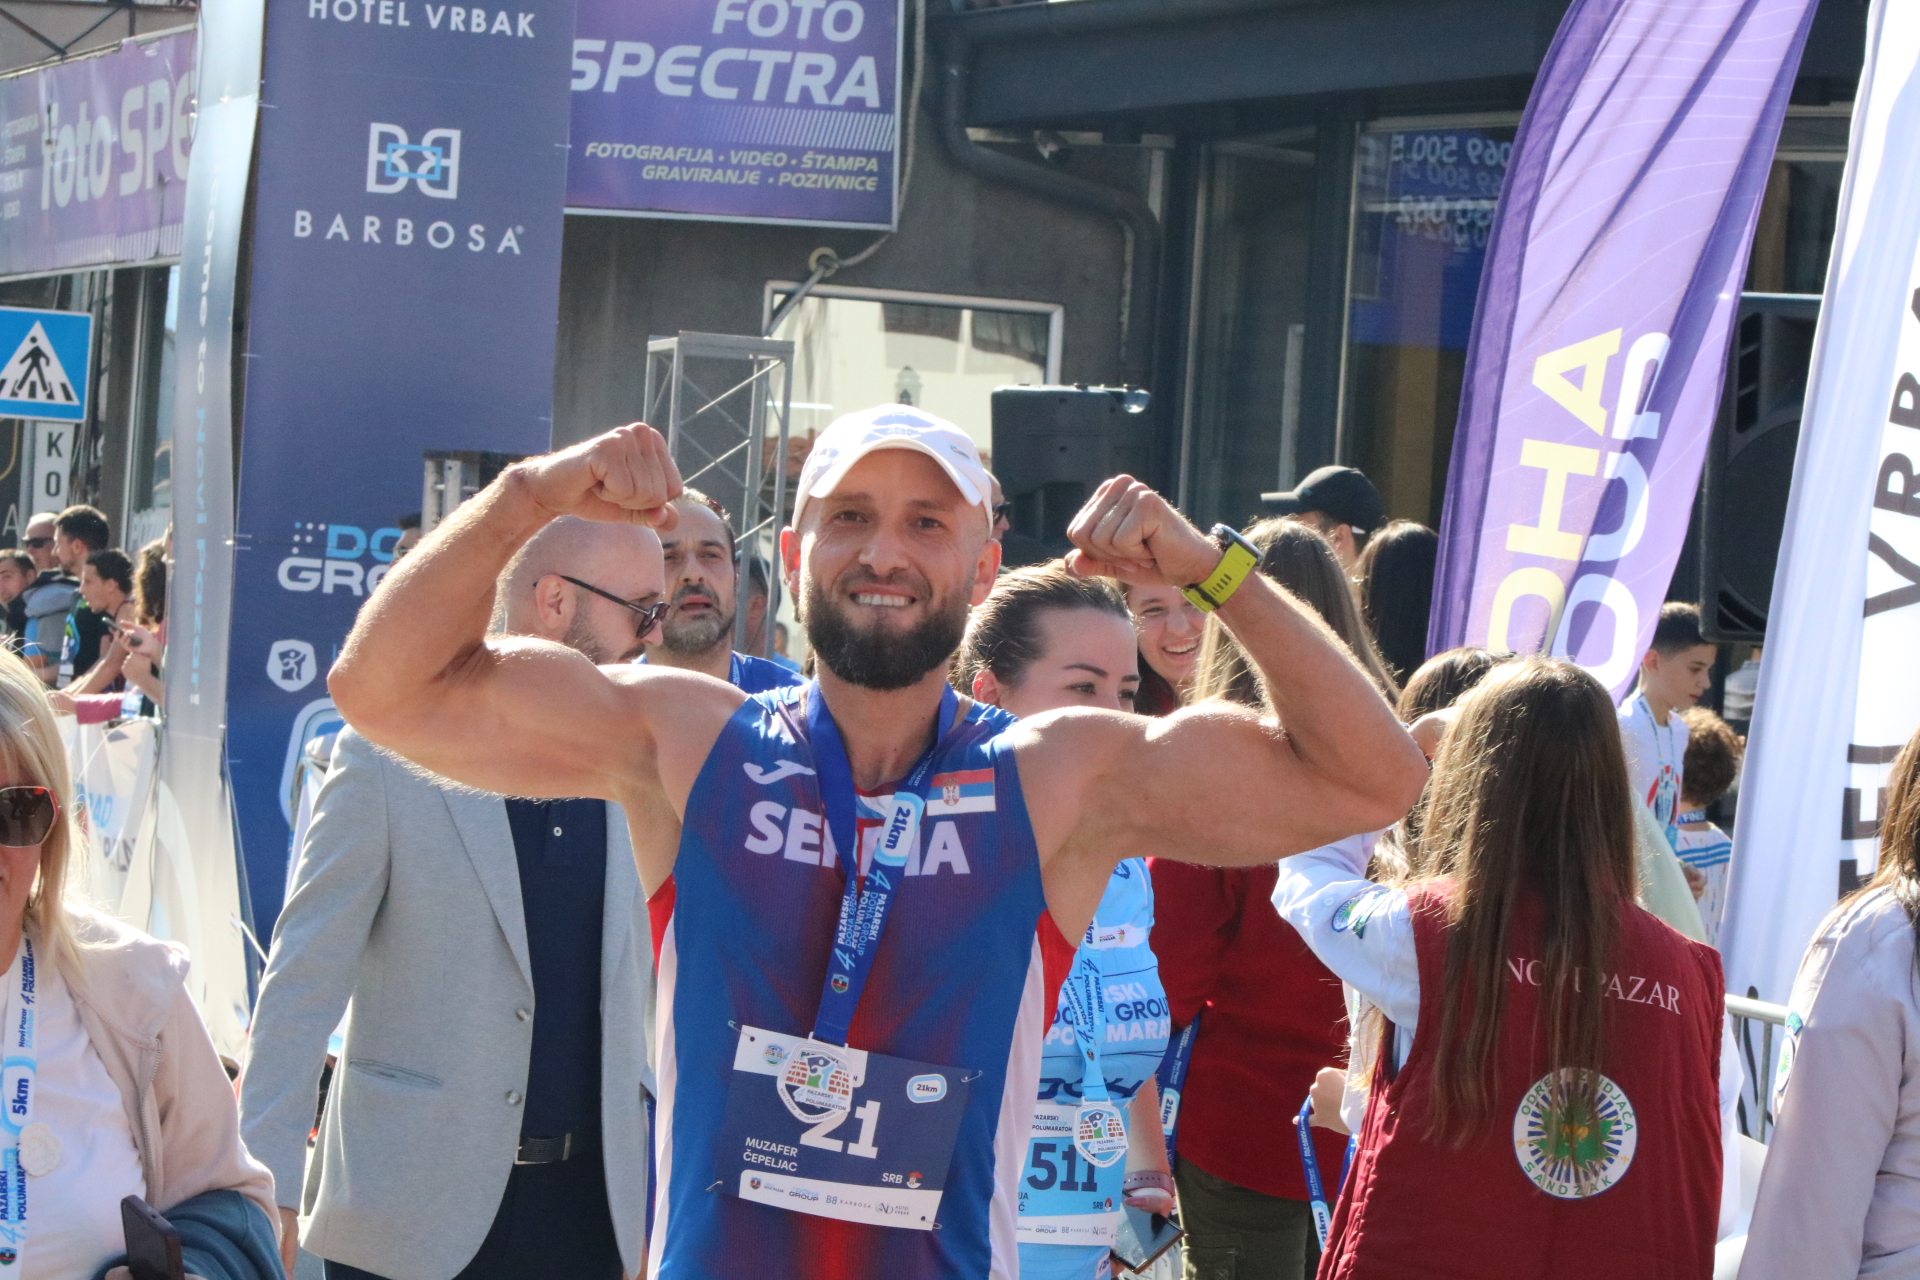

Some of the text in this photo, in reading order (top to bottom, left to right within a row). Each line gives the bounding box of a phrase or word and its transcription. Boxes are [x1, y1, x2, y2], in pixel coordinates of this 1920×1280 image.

[308, 0, 536, 38] HOTEL VRBAK
[711, 0, 866, 43] FOTO
[570, 38, 882, 109] SPECTRA
[585, 141, 879, 173] FOTOGRAFIJA VIDEO ŠTAMPA
[641, 164, 879, 192] GRAVIRANJE POZIVNICE
[294, 210, 521, 255] BARBOSA
[744, 800, 972, 878] SEIA
[885, 806, 912, 850] 21km
[837, 895, 851, 945] PAZARSKI
[857, 891, 879, 956] DOHA GROUP
[867, 893, 888, 941] PAZARSKI
[1094, 976, 1105, 1013] PAZARSKI
[12, 1077, 30, 1117] 5km
[915, 1083, 939, 1094] 21km
[800, 1099, 881, 1159] 21
[1161, 1097, 1174, 1125] 21km
[743, 1148, 798, 1173] ČEPELJAC
[745, 1136, 799, 1158] MUZAFER
[881, 1172, 903, 1184] SRB
[1026, 1142, 1098, 1193] 511
[789, 1191, 819, 1202] GROUP
[1092, 1201, 1104, 1210] SRB
